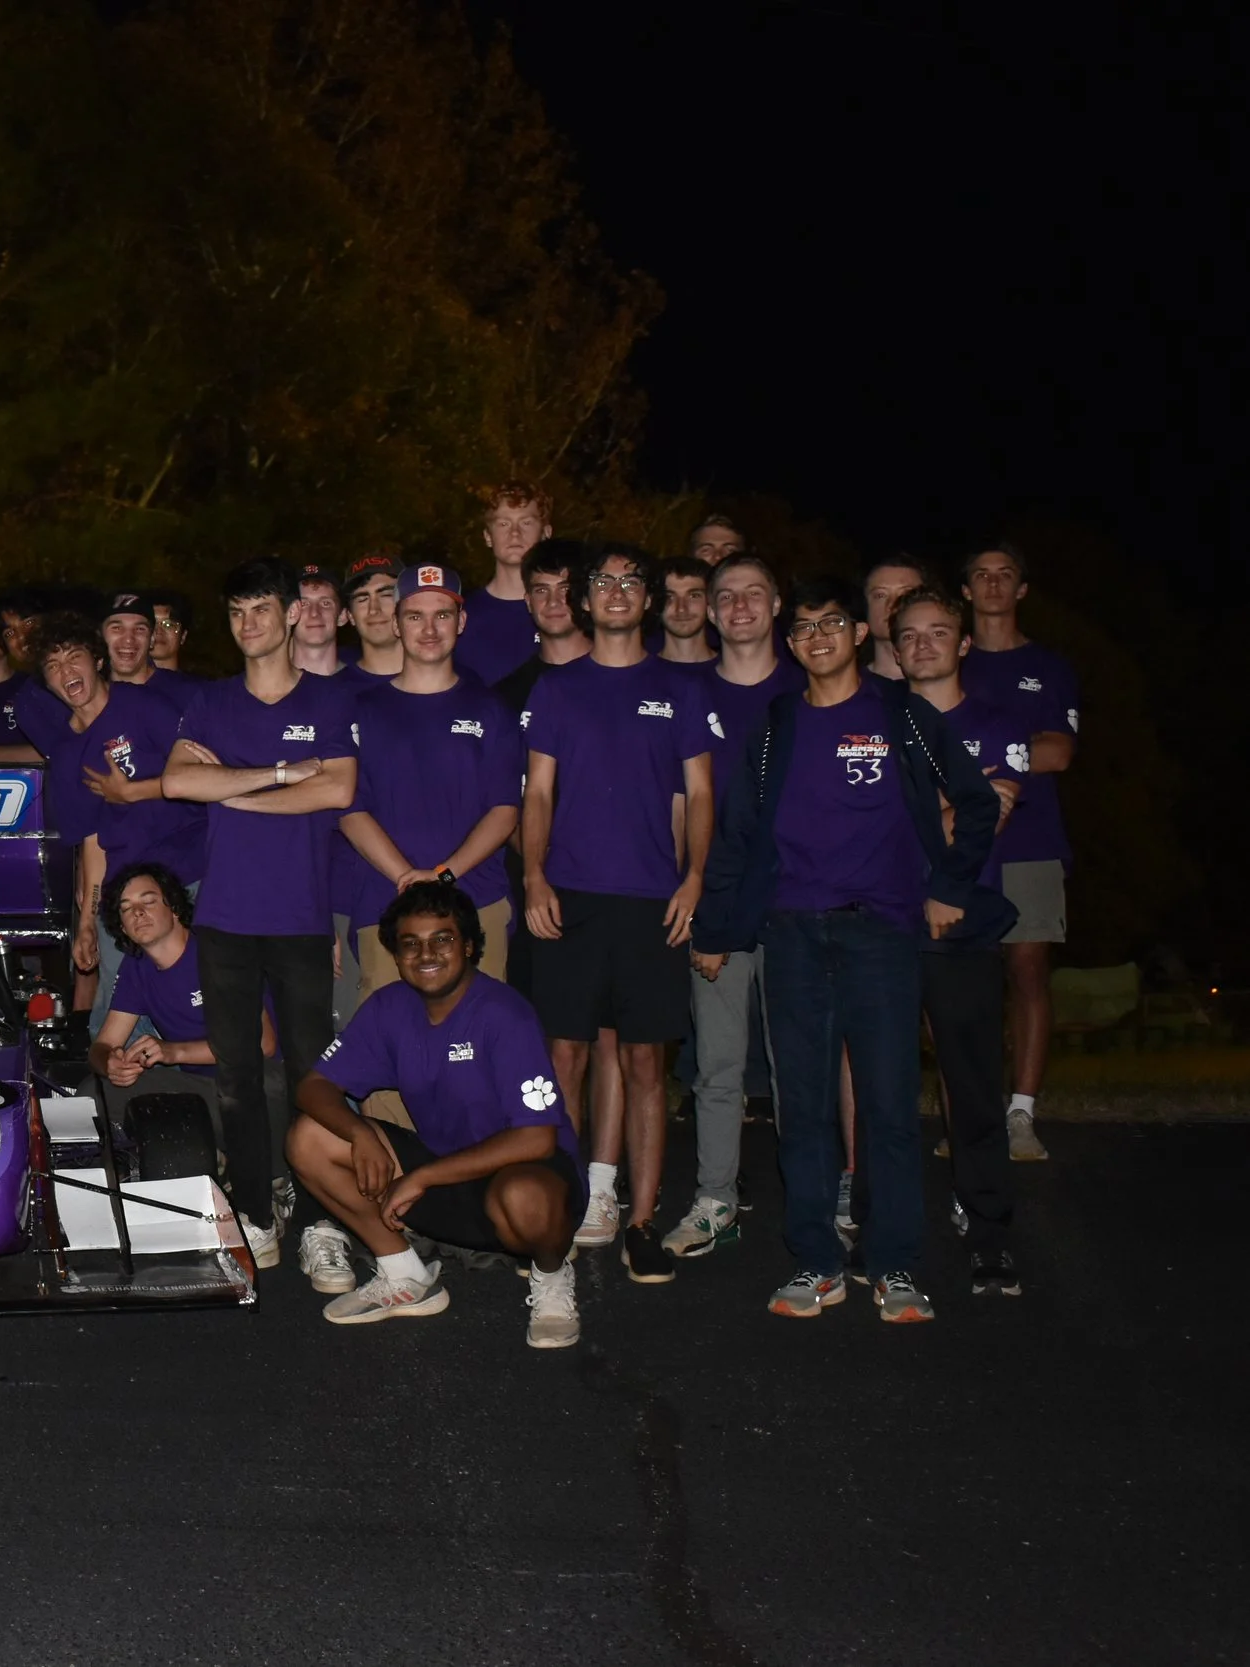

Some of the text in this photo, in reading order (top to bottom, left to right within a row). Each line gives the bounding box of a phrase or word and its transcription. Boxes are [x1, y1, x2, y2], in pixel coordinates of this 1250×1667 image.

[352, 557, 392, 575] NASA
[838, 744, 889, 753] CLEMSON
[846, 758, 882, 784] 53
[90, 1281, 235, 1293] MECHANICAL ENGINEERING
